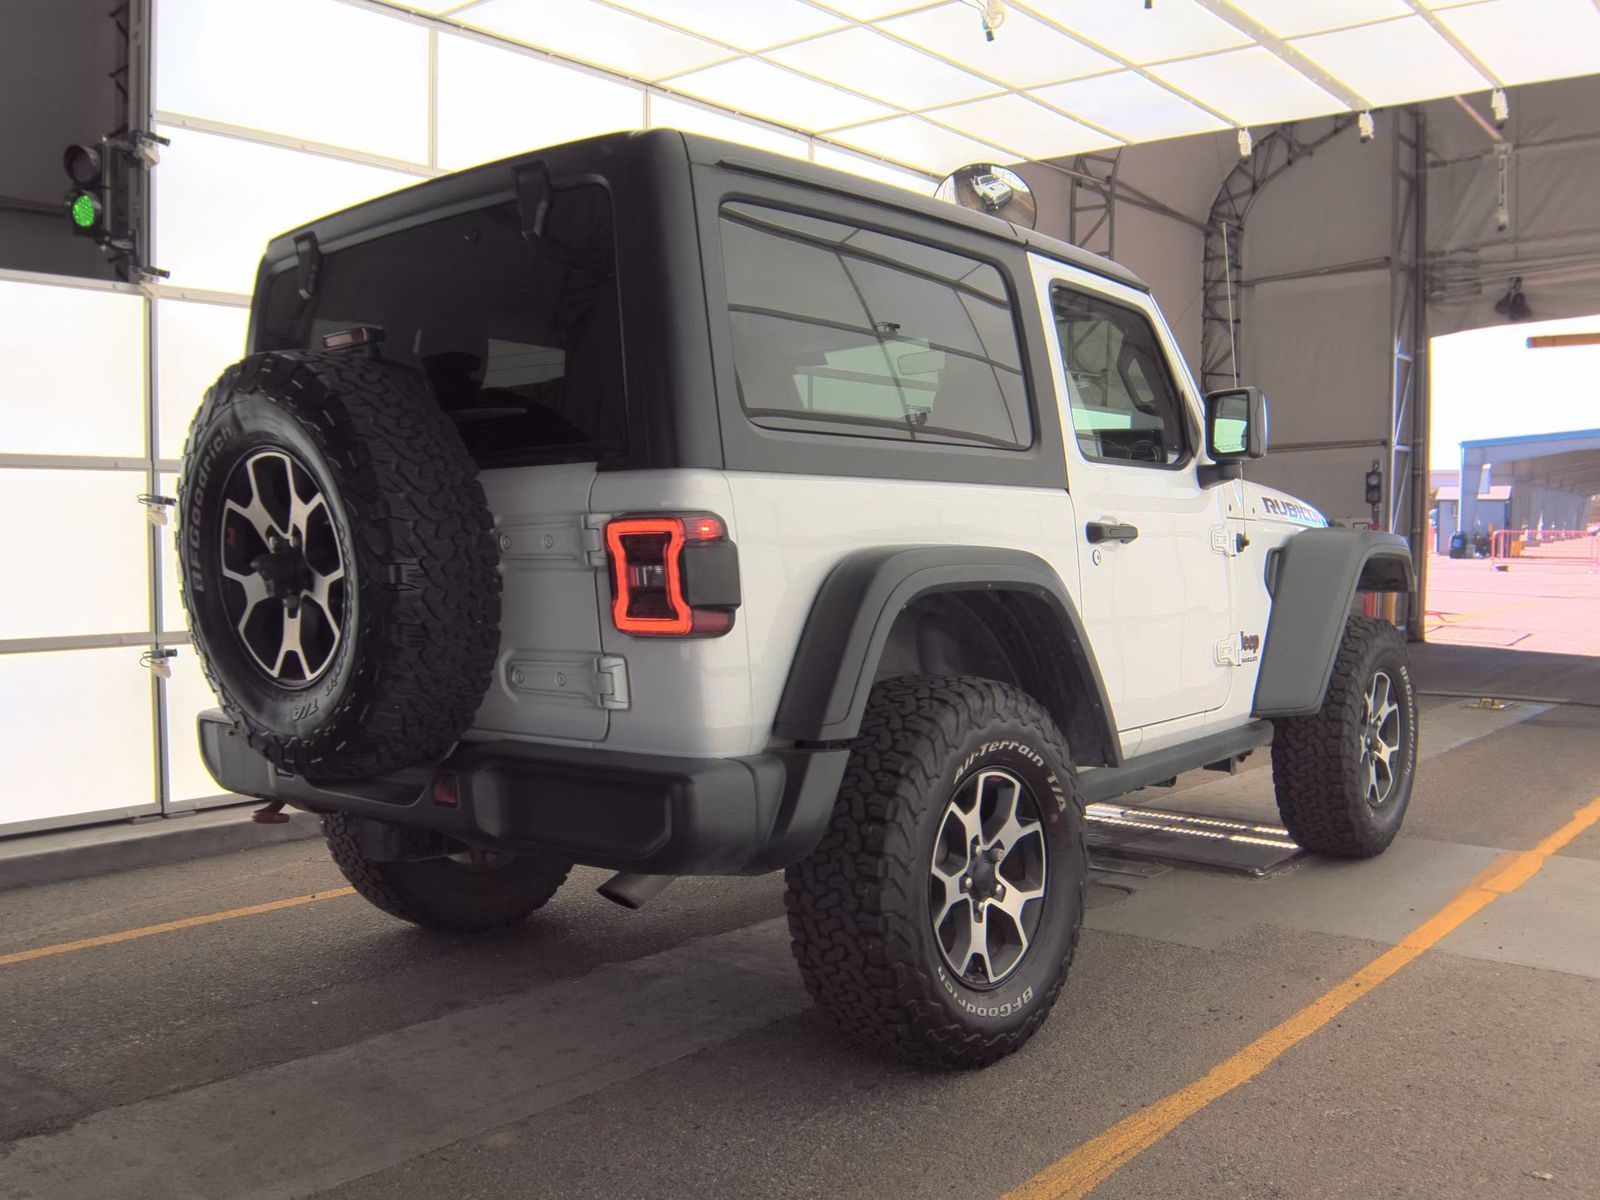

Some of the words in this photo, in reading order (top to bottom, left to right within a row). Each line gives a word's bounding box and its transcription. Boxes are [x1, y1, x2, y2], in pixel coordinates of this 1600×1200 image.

[188, 424, 235, 592] BFGoodrich
[1240, 630, 1259, 654] Jeep
[1400, 665, 1416, 776] BFGoodrich
[953, 740, 1045, 785] All-Terrain
[1046, 770, 1067, 813] T/A
[937, 965, 1034, 1017] BFGoodrich
